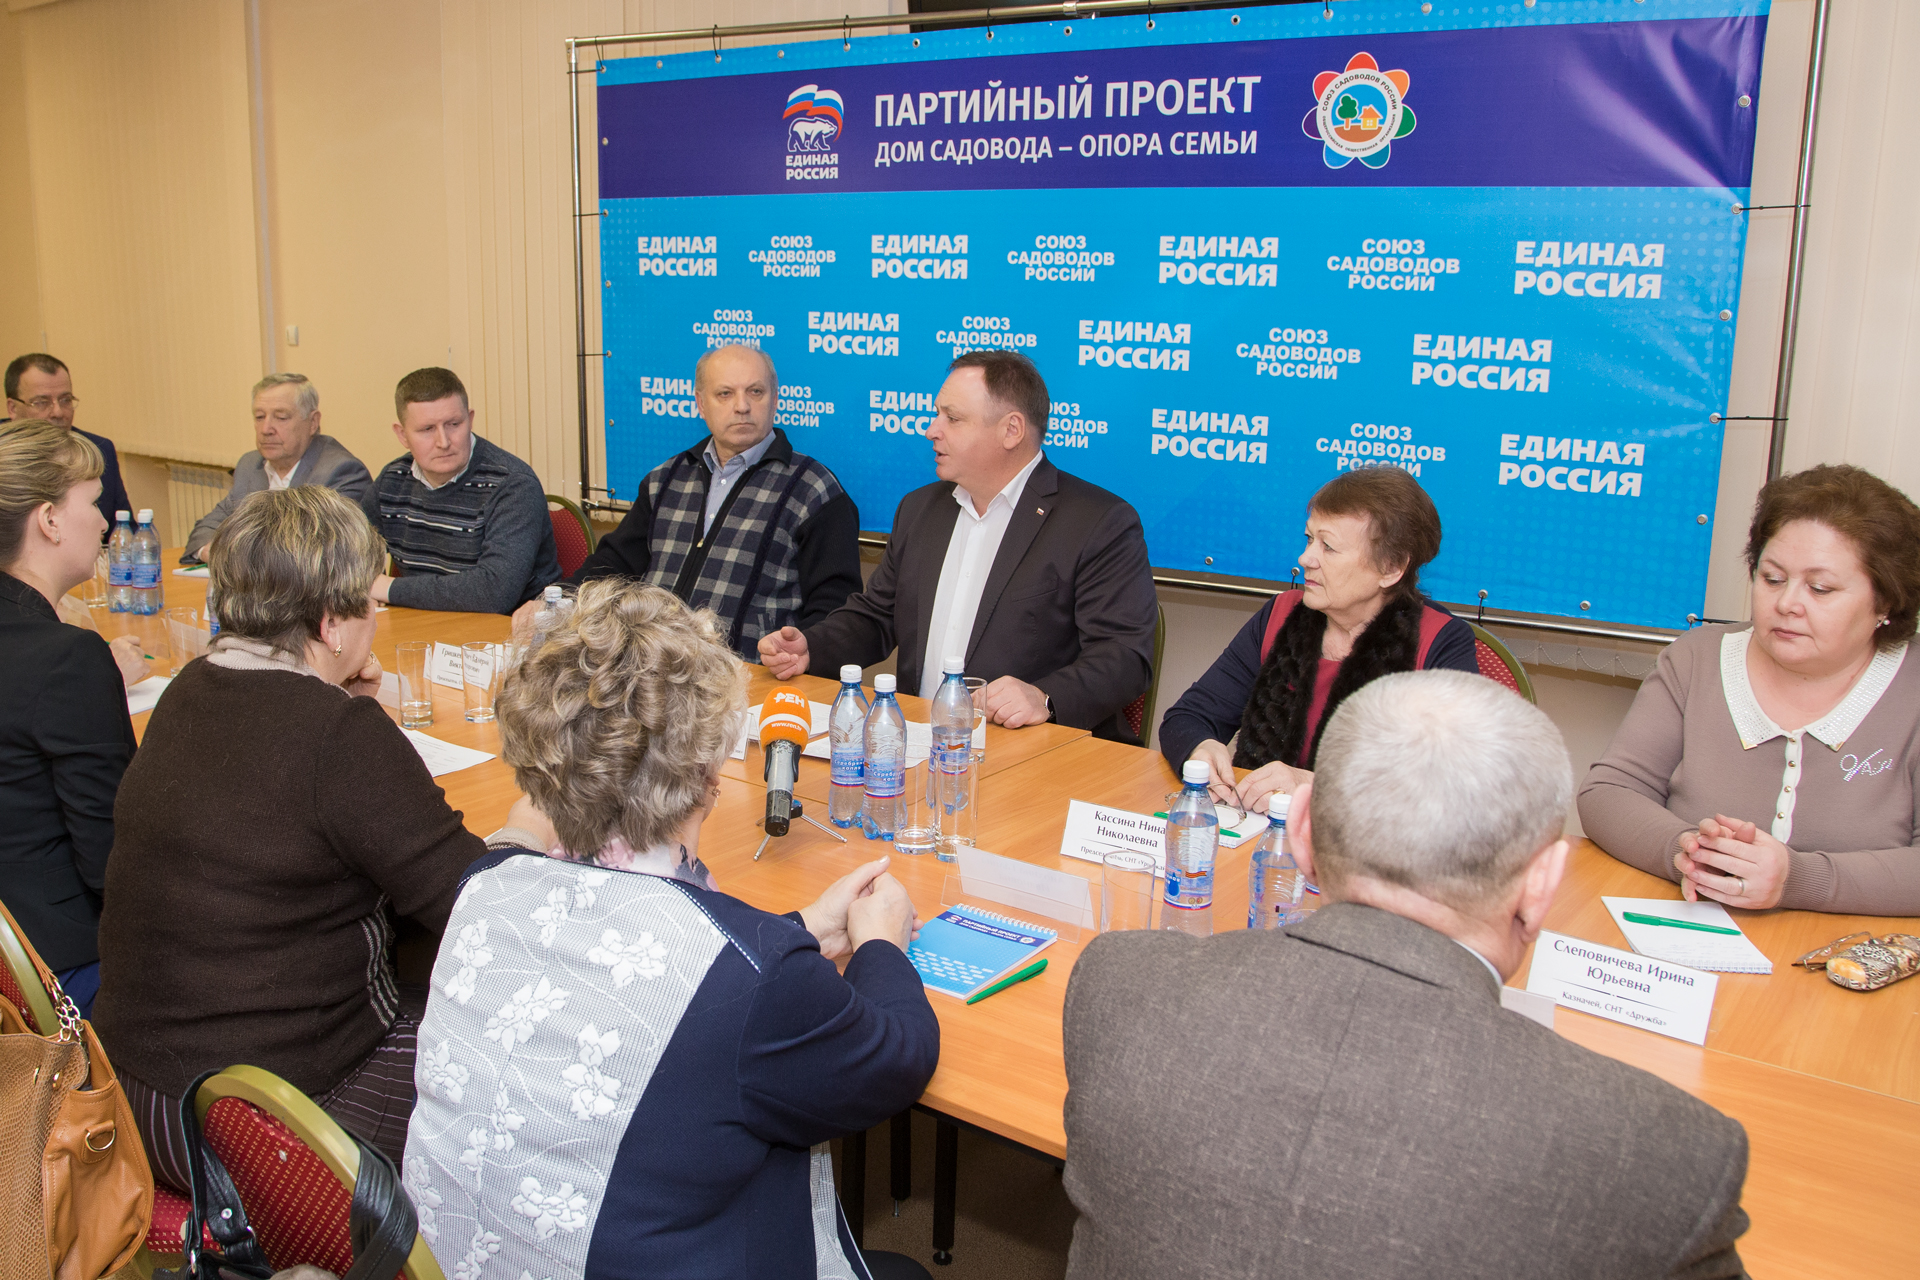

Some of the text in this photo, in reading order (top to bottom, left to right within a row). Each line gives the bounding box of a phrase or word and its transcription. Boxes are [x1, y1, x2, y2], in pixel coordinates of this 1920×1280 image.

[874, 75, 1262, 127] ПАРТИЙНЫЙ ПРОЕКТ
[1322, 73, 1397, 111] СОЮЗ САДОВОДОВ РОССИИ
[785, 152, 839, 168] ЕДИНАЯ
[874, 140, 925, 168] ДОМ
[930, 136, 1054, 166] САДОВОДА
[1079, 132, 1164, 157] ОПОРА
[1169, 130, 1258, 155] СЕМЬИ
[785, 166, 839, 181] РОССИЯ
[637, 235, 717, 256] ЕДИНАЯ
[770, 235, 813, 249] СОЮЗ
[871, 234, 969, 257] ЕДИНАЯ
[1035, 234, 1087, 250] СОЮЗ
[1159, 235, 1279, 260] ЕДИНАЯ
[1362, 238, 1426, 255] СОЮЗ
[748, 249, 836, 266] САДОВОДОВ
[1007, 250, 1115, 269] САДОВОДОВ
[1326, 255, 1460, 275] САДОВОДОВ
[1515, 240, 1666, 268] ЕДИНАЯ
[638, 257, 718, 277] РОССИЯ
[763, 265, 821, 278] РОССИИ
[871, 258, 968, 280] РОССИЯ
[1024, 267, 1096, 282] РОССИИ
[1158, 261, 1278, 287] РОССИЯ
[1348, 274, 1436, 292] РОССИИ
[1513, 269, 1663, 300] РОССИЯ
[713, 309, 753, 323] СОЮЗ
[808, 311, 900, 333] ЕДИНАЯ
[962, 315, 1011, 331] СОЮЗ
[692, 322, 776, 340] САДОВОДОВ
[935, 330, 1038, 349] САДОВОДОВ
[1078, 319, 1192, 345] ЕДИНАЯ
[1268, 327, 1329, 345] СОЮЗ
[808, 333, 899, 357] РОССИЯ
[1236, 342, 1361, 365] САДОВОДОВ
[1412, 333, 1553, 363] ЕДИНАЯ
[1078, 344, 1190, 372] РОССИЯ
[1256, 361, 1338, 380] РОССИИ
[1411, 362, 1551, 393] РОССИЯ
[640, 376, 696, 397] ЕДИН
[776, 384, 812, 399] ОЮЗ
[641, 397, 703, 419] РОССИ
[776, 398, 835, 415] ОВОДОВ
[869, 389, 938, 413] ЕДИН
[1048, 401, 1081, 417] ЮЗ
[773, 412, 820, 428] ОССИИ
[869, 412, 937, 437] РОСС
[1048, 417, 1109, 436] ВОДОВ
[1151, 408, 1269, 437] ЕДИНАЯ
[1042, 432, 1090, 449] ССИИ
[1350, 422, 1412, 442] СОЮЗ
[1151, 435, 1268, 464] РОССИЯ
[1315, 437, 1446, 463] САДОВОДОВ
[1500, 433, 1646, 467] ЕДИНАЯ
[1498, 461, 1643, 497] РОССИЯ
[773, 692, 805, 708] РЕН
[1094, 810, 1166, 835] Кассина Нина
[1096, 825, 1158, 848] Николаевна
[1553, 939, 1642, 974] Слеповичева
[1647, 963, 1695, 987] Ирина
[1586, 965, 1651, 994] Юрьевна
[1562, 991, 1667, 1027] Казначей, СНТ «Дружба»
